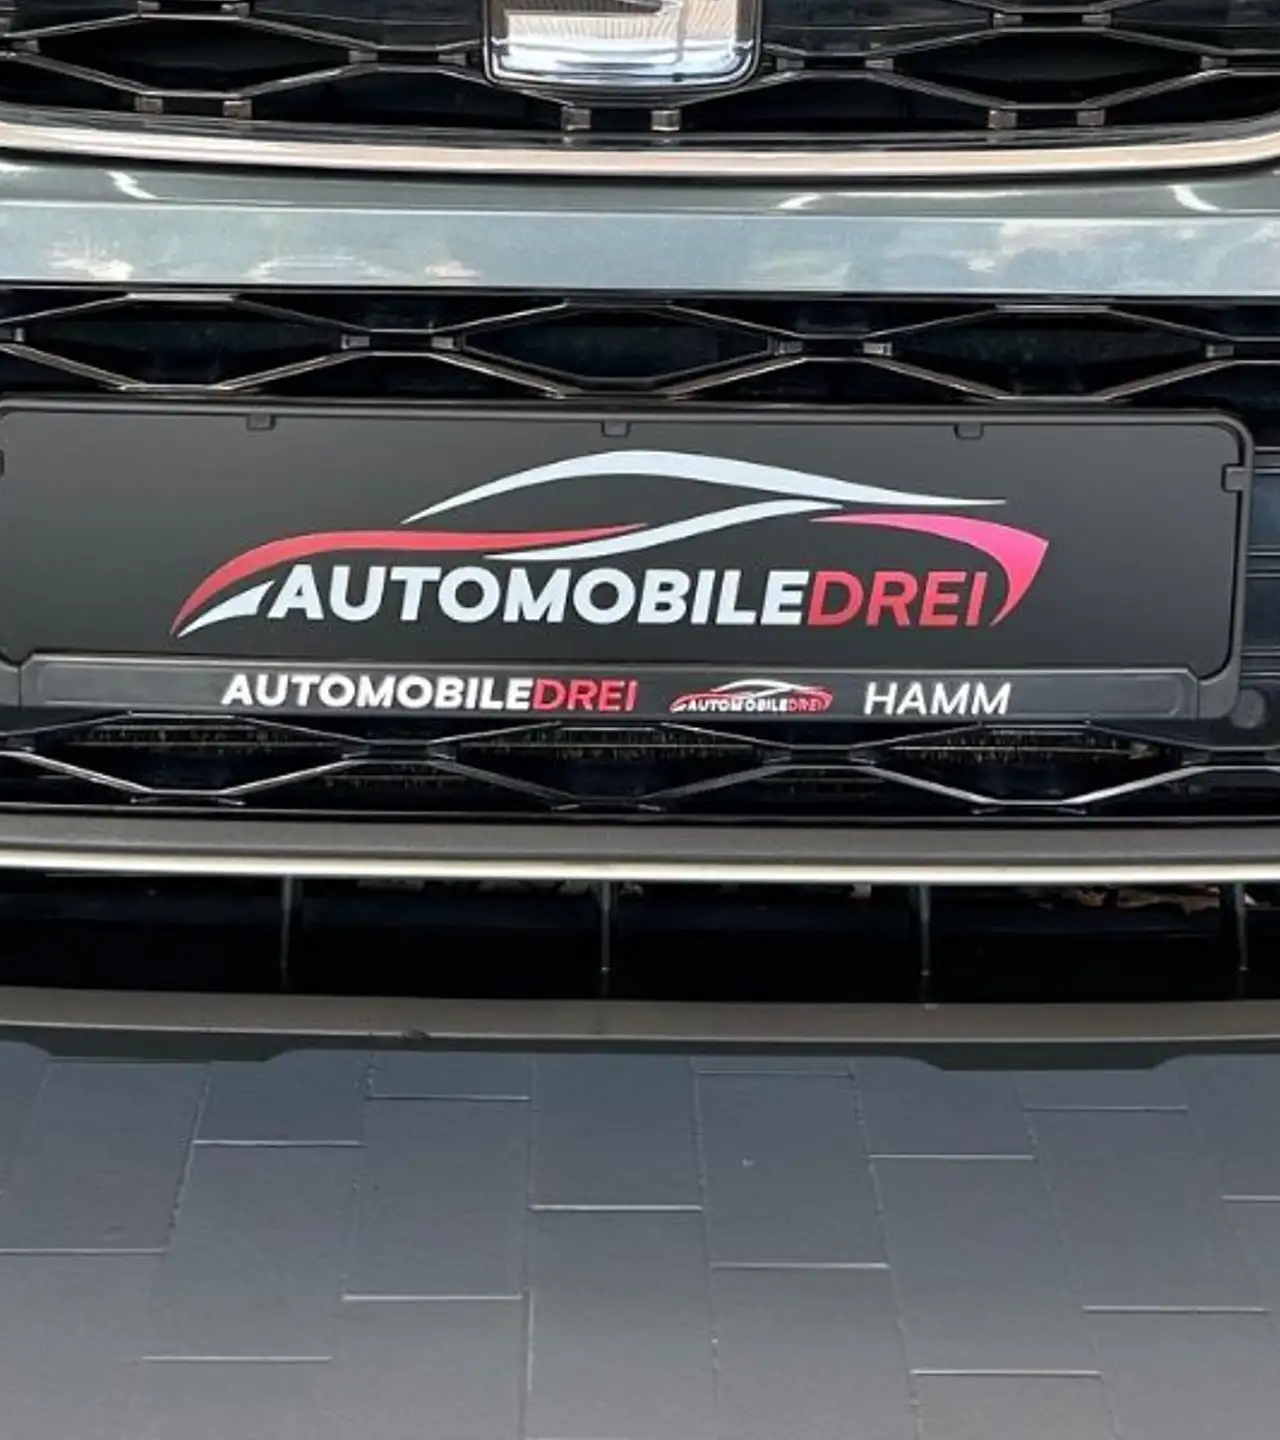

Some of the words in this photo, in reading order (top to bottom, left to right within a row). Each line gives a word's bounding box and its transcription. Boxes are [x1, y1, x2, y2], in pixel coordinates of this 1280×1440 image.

[266, 564, 989, 627] AUTOMOBILEDREI
[222, 673, 638, 713] AUTOMOBILEDREI
[863, 681, 1012, 716] HAMM
